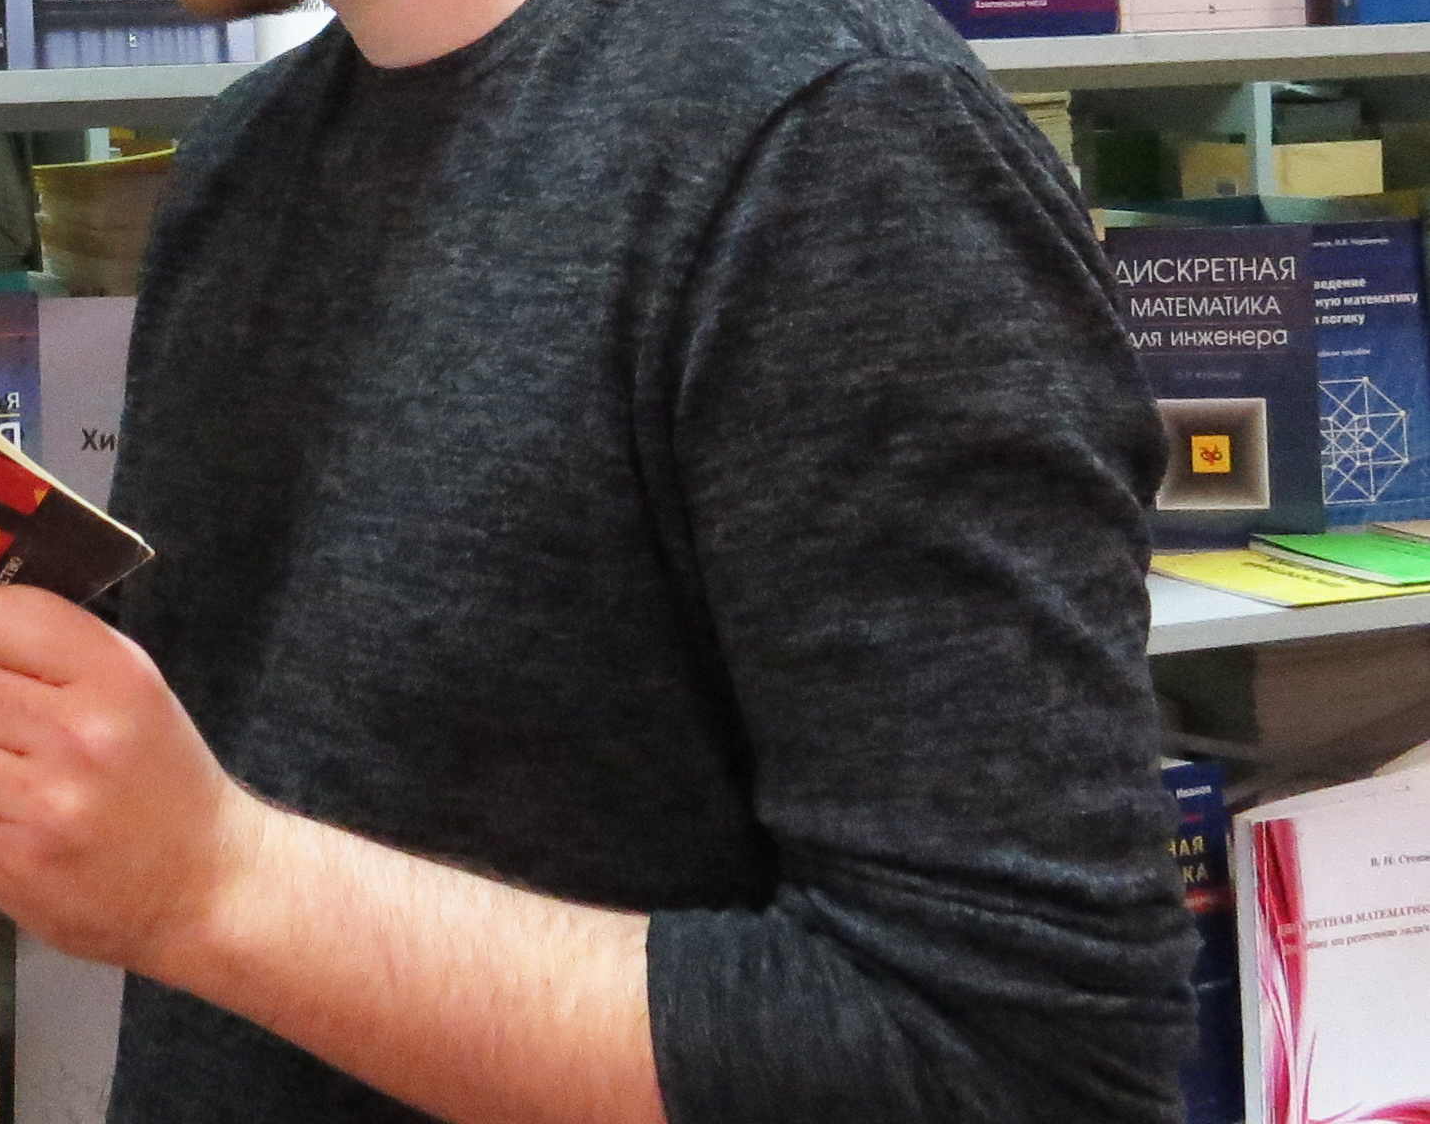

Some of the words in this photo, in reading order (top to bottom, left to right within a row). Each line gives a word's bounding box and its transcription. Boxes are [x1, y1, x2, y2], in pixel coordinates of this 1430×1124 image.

[1117, 256, 1297, 287] ДИСКРЕТНАЯ
[1130, 294, 1282, 318] МАТЕМАТИКА
[1171, 327, 1288, 350] инженера
